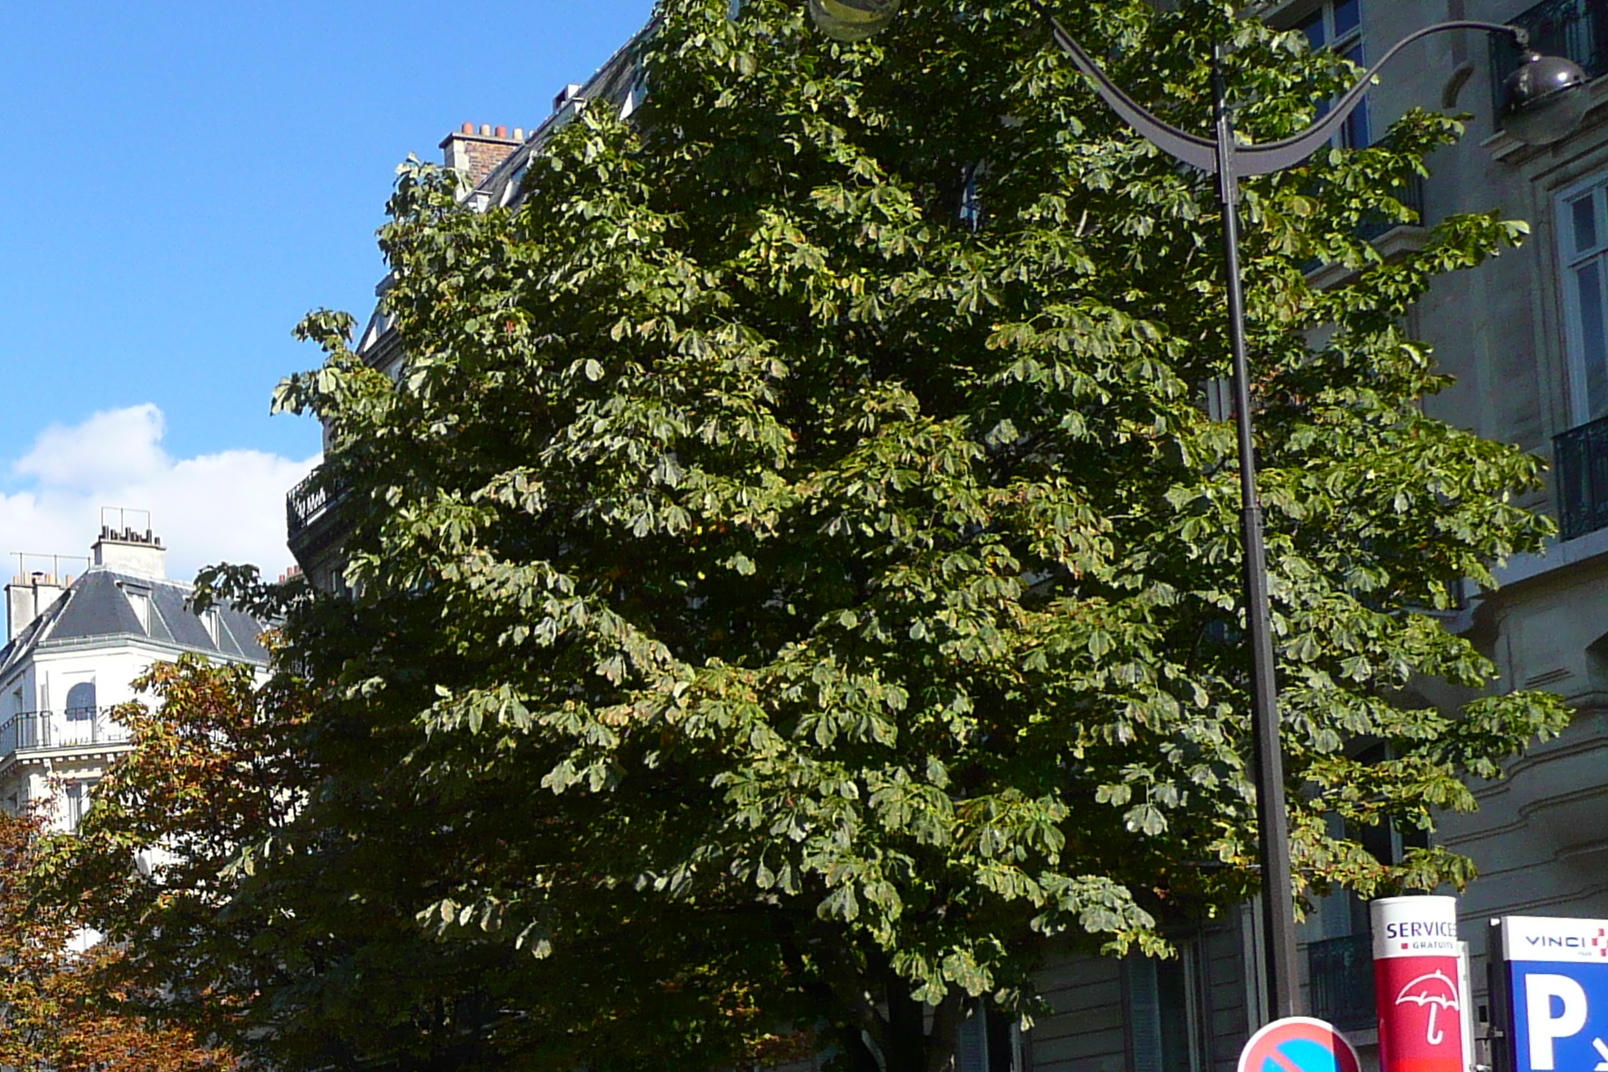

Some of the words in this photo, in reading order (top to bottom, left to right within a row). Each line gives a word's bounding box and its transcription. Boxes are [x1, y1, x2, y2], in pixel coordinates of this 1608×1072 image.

[1412, 941, 1453, 949] GRATUITS
[1525, 935, 1586, 948] VINCI
[1525, 973, 1588, 1071] P
